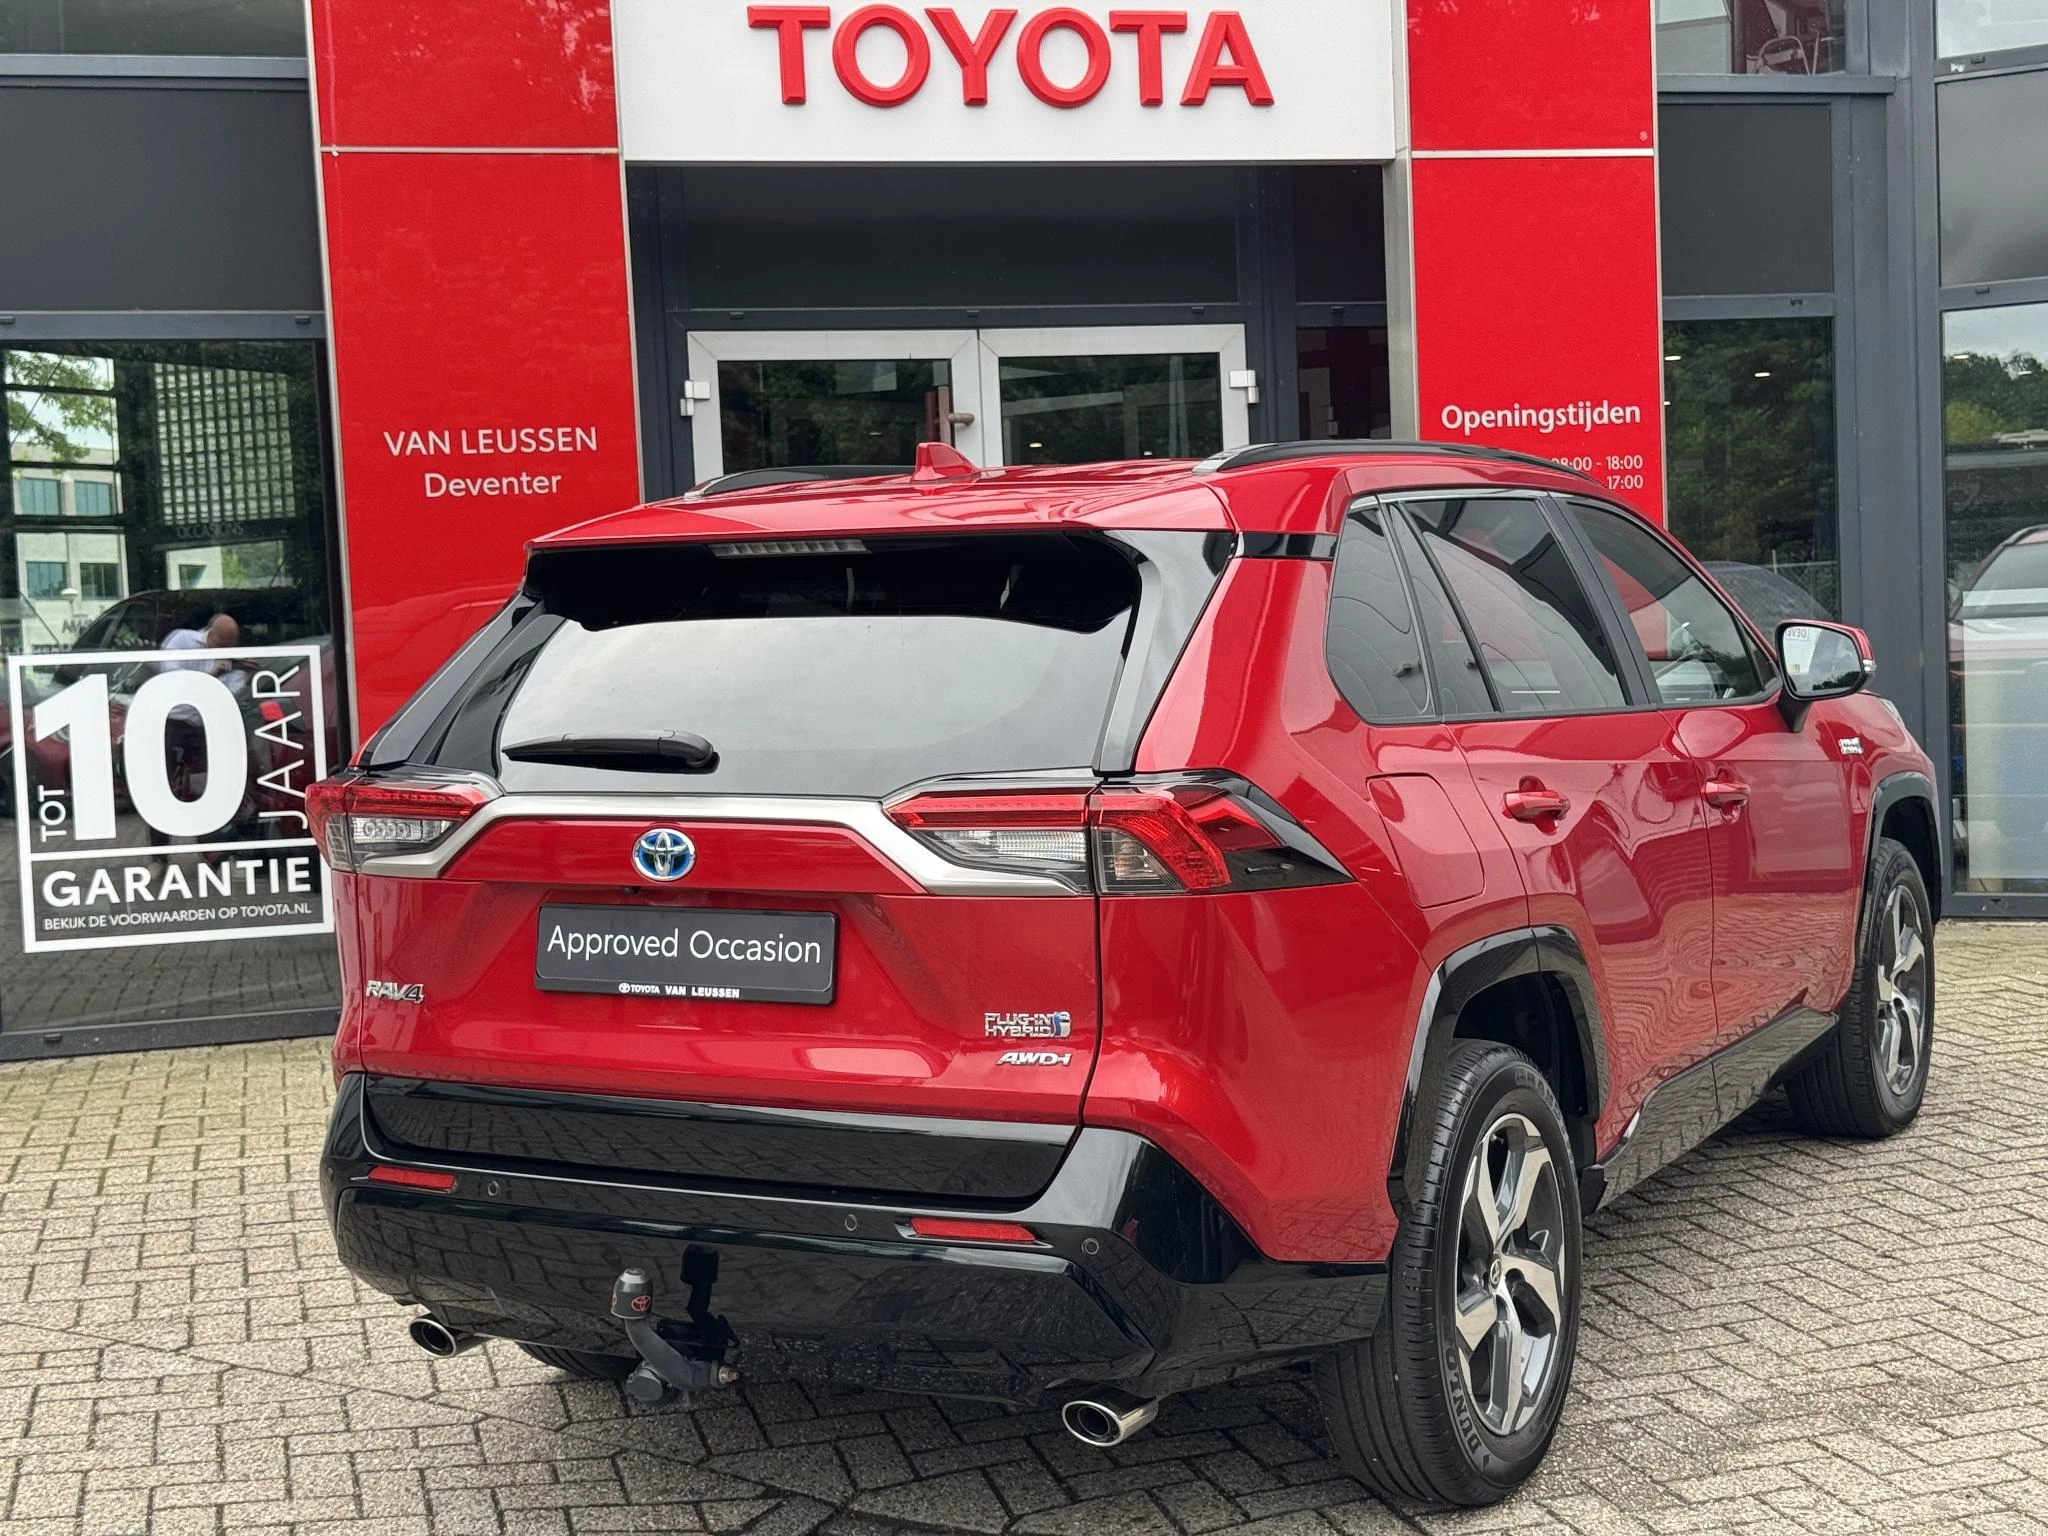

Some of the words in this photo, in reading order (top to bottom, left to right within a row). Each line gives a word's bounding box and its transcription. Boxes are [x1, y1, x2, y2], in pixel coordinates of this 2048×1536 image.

[748, 4, 1275, 108] TOYOTA
[1441, 400, 1641, 435] Openingstijden
[383, 430, 451, 456] VAN
[461, 426, 598, 454] LEUSSEN
[1605, 455, 1643, 470] 18:00
[424, 471, 562, 498] Deventer
[1606, 474, 1644, 490] 17:00
[33, 669, 248, 841] 10
[251, 665, 309, 830] JAAR
[37, 784, 67, 843] TOT
[42, 857, 312, 908] GARANTIE
[43, 915, 87, 931] BEKIJK
[89, 914, 107, 928] DE
[109, 907, 216, 927] VOORWAARDEN
[218, 904, 238, 919] OP
[241, 901, 312, 918] TOYOTA.NL
[547, 914, 678, 961] Approved
[690, 929, 821, 963] Occasion
[366, 980, 424, 1004] RAV4
[631, 983, 660, 994] TOYOTA
[665, 984, 686, 996] VAN
[692, 986, 740, 999] LEUSSEN
[984, 1012, 1053, 1026] PLUG-IN
[985, 1025, 1054, 1037] HYBRID
[996, 1052, 1071, 1066] AWD-i
[1445, 1337, 1483, 1454] DUNLO
